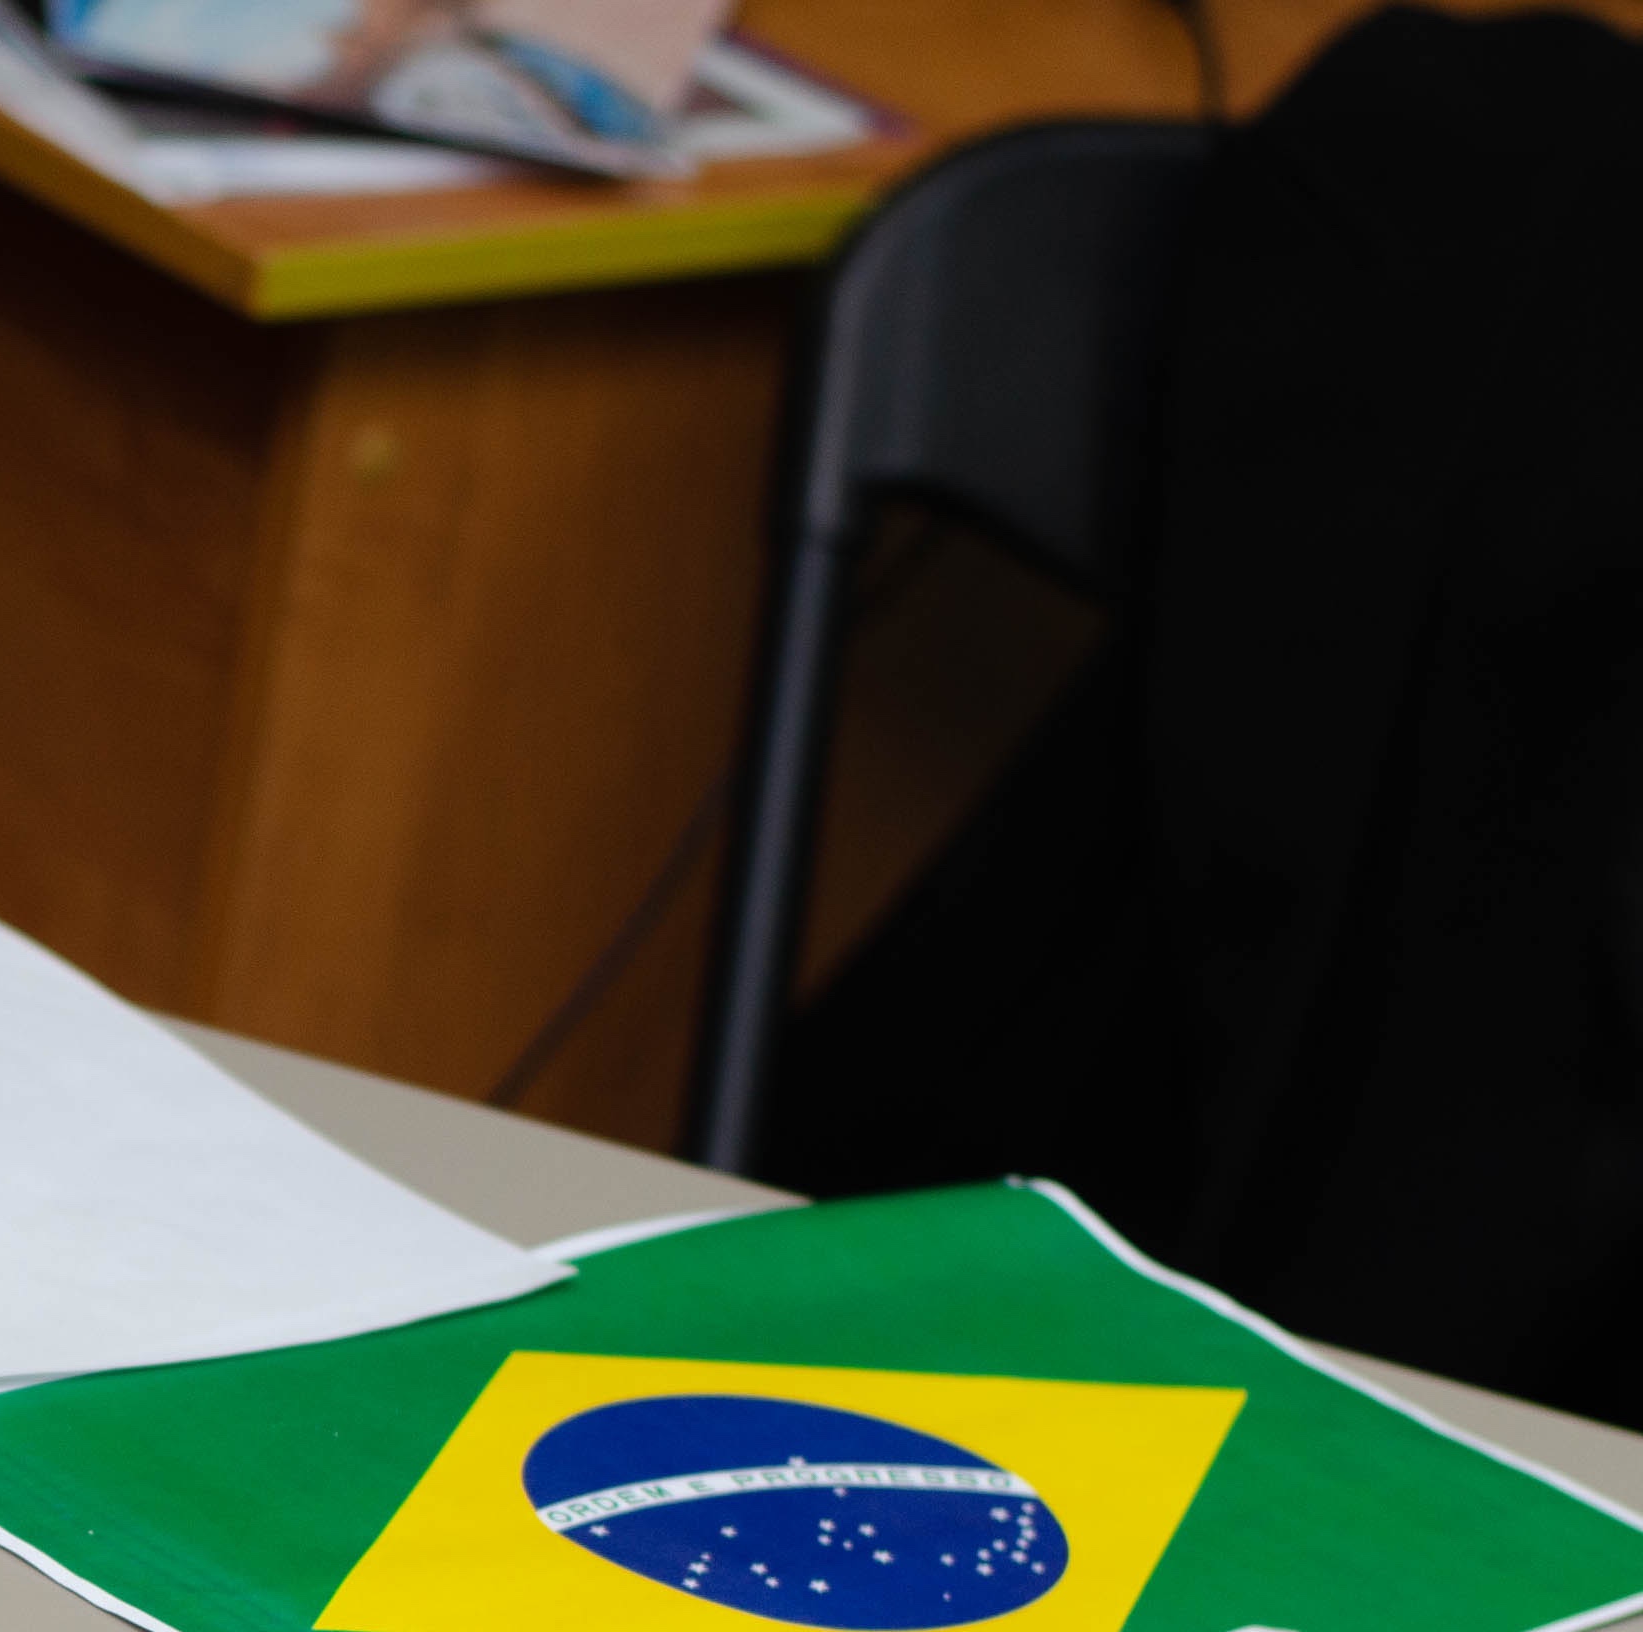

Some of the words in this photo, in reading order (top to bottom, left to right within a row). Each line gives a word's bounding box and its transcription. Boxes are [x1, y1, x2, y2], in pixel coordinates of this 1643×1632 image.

[547, 1485, 675, 1524] ORDEM
[688, 1480, 709, 1492] E
[731, 1470, 1012, 1488] PROGRESSO
